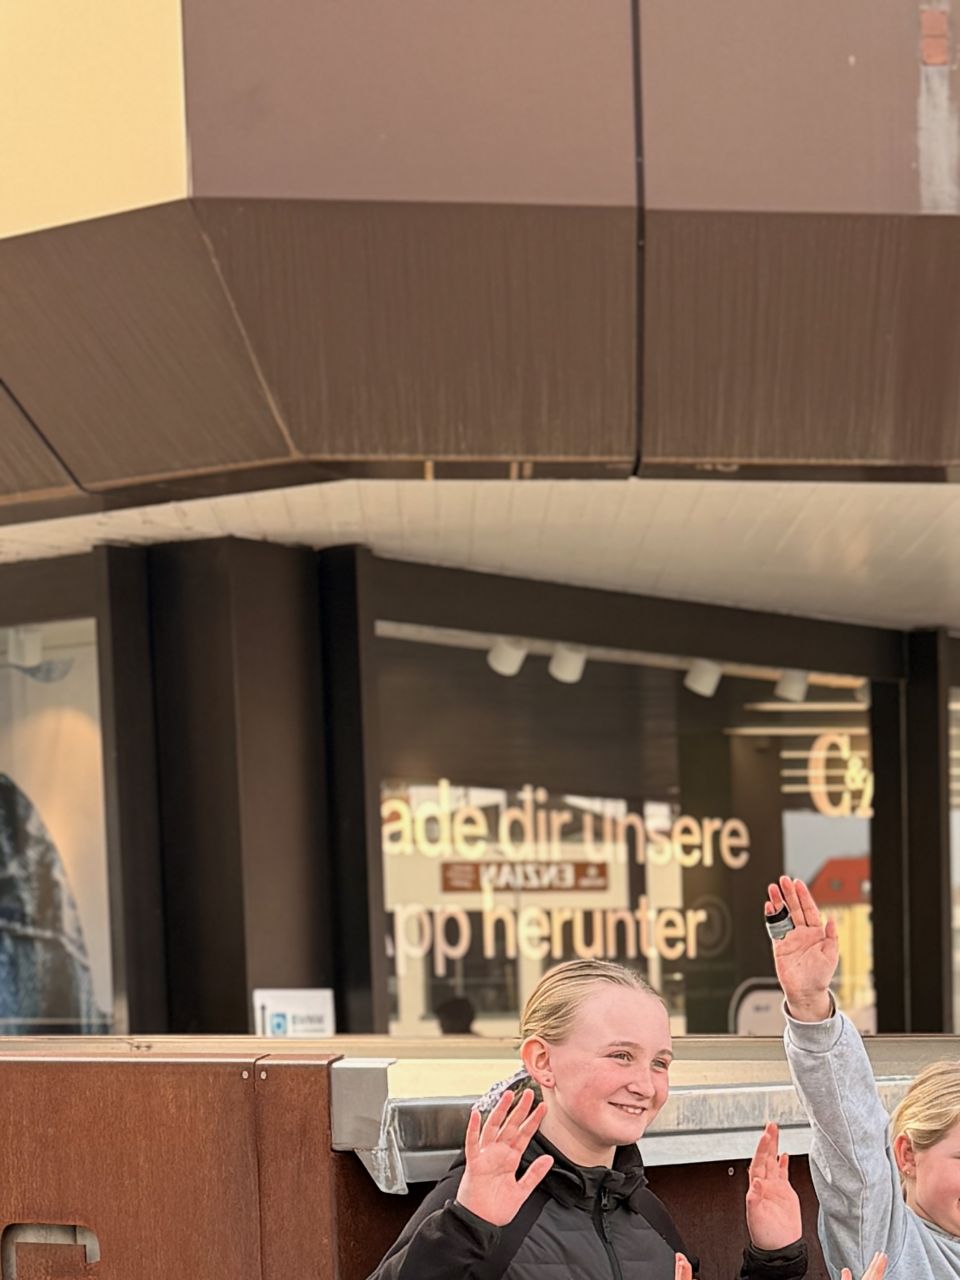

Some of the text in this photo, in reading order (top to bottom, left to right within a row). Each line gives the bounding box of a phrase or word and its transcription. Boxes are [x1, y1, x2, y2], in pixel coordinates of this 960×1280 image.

[500, 784, 573, 860] dir
[582, 806, 750, 869] unsere
[385, 876, 707, 977] pp herunter
